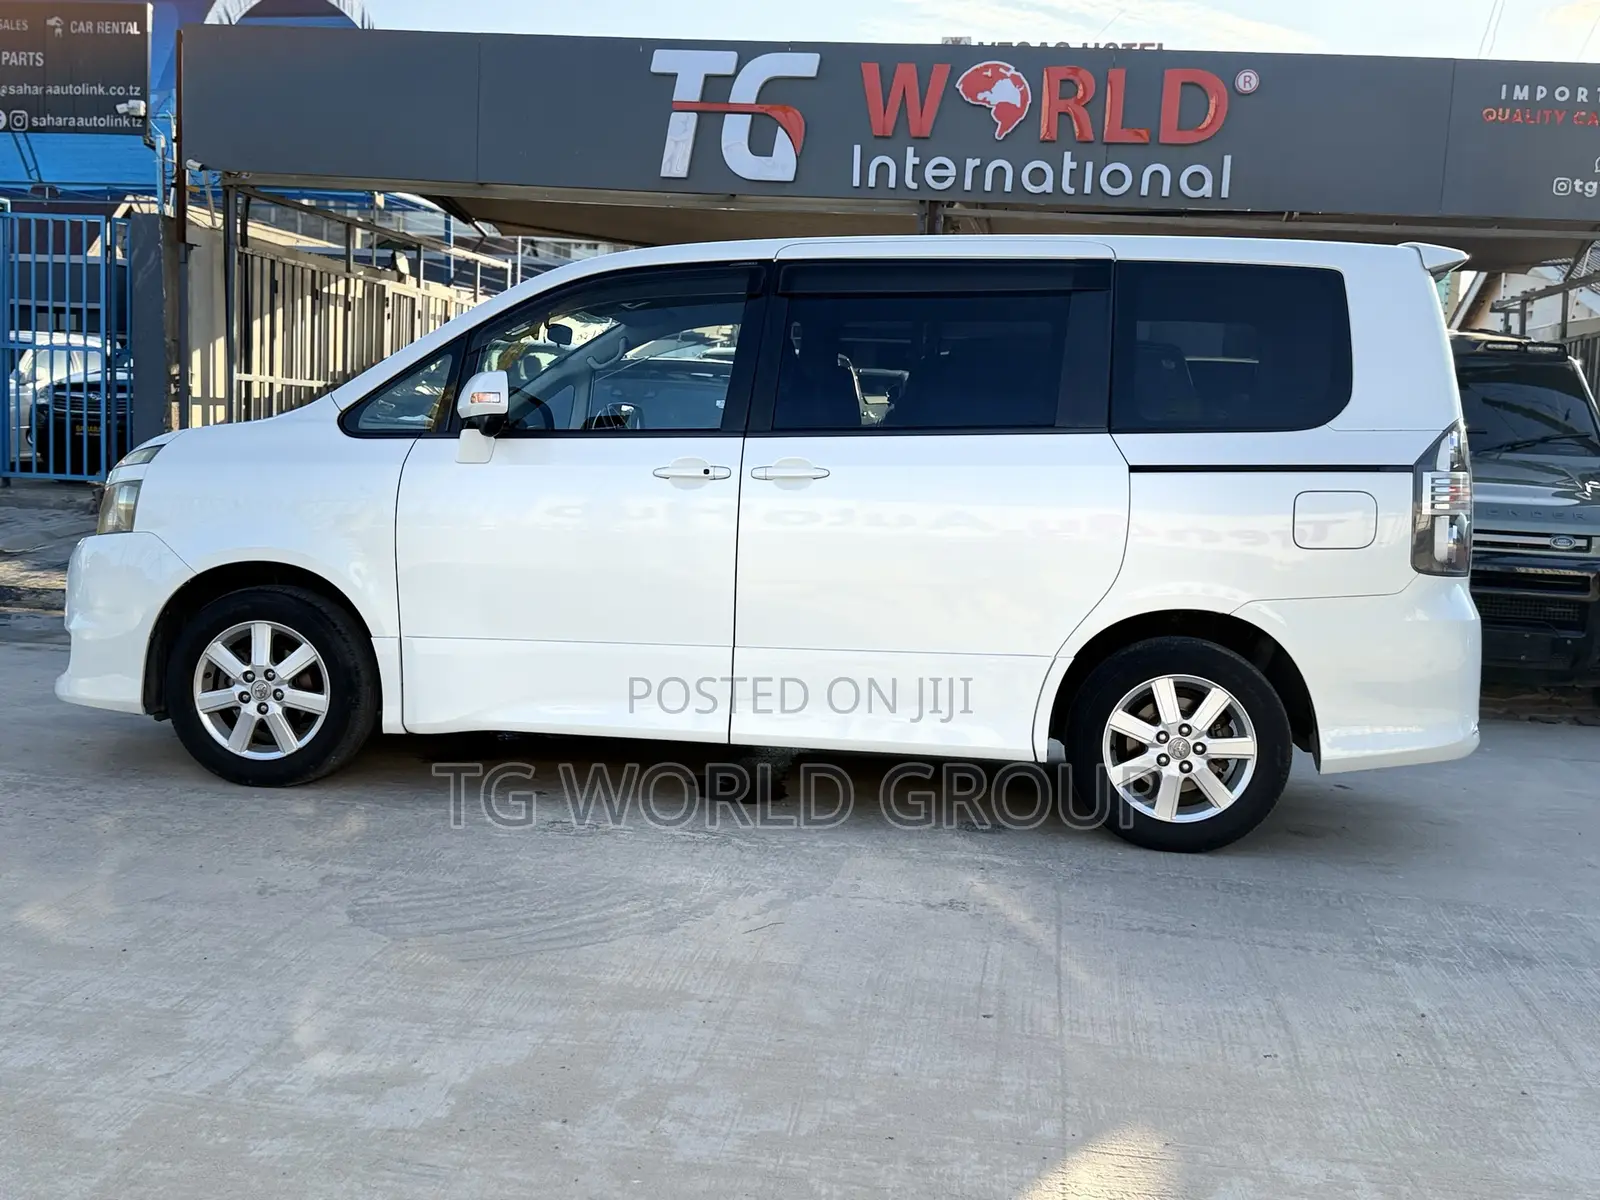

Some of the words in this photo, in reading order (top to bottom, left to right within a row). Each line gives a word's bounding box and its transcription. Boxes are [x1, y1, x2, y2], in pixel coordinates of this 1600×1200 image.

[70, 21, 94, 34] CAR
[97, 21, 141, 35] RENTAL
[1, 51, 45, 67] PARTS
[650, 49, 821, 182] TG
[1482, 107, 1567, 124] QUALITY
[852, 144, 1232, 199] International
[1573, 178, 1600, 198] tg
